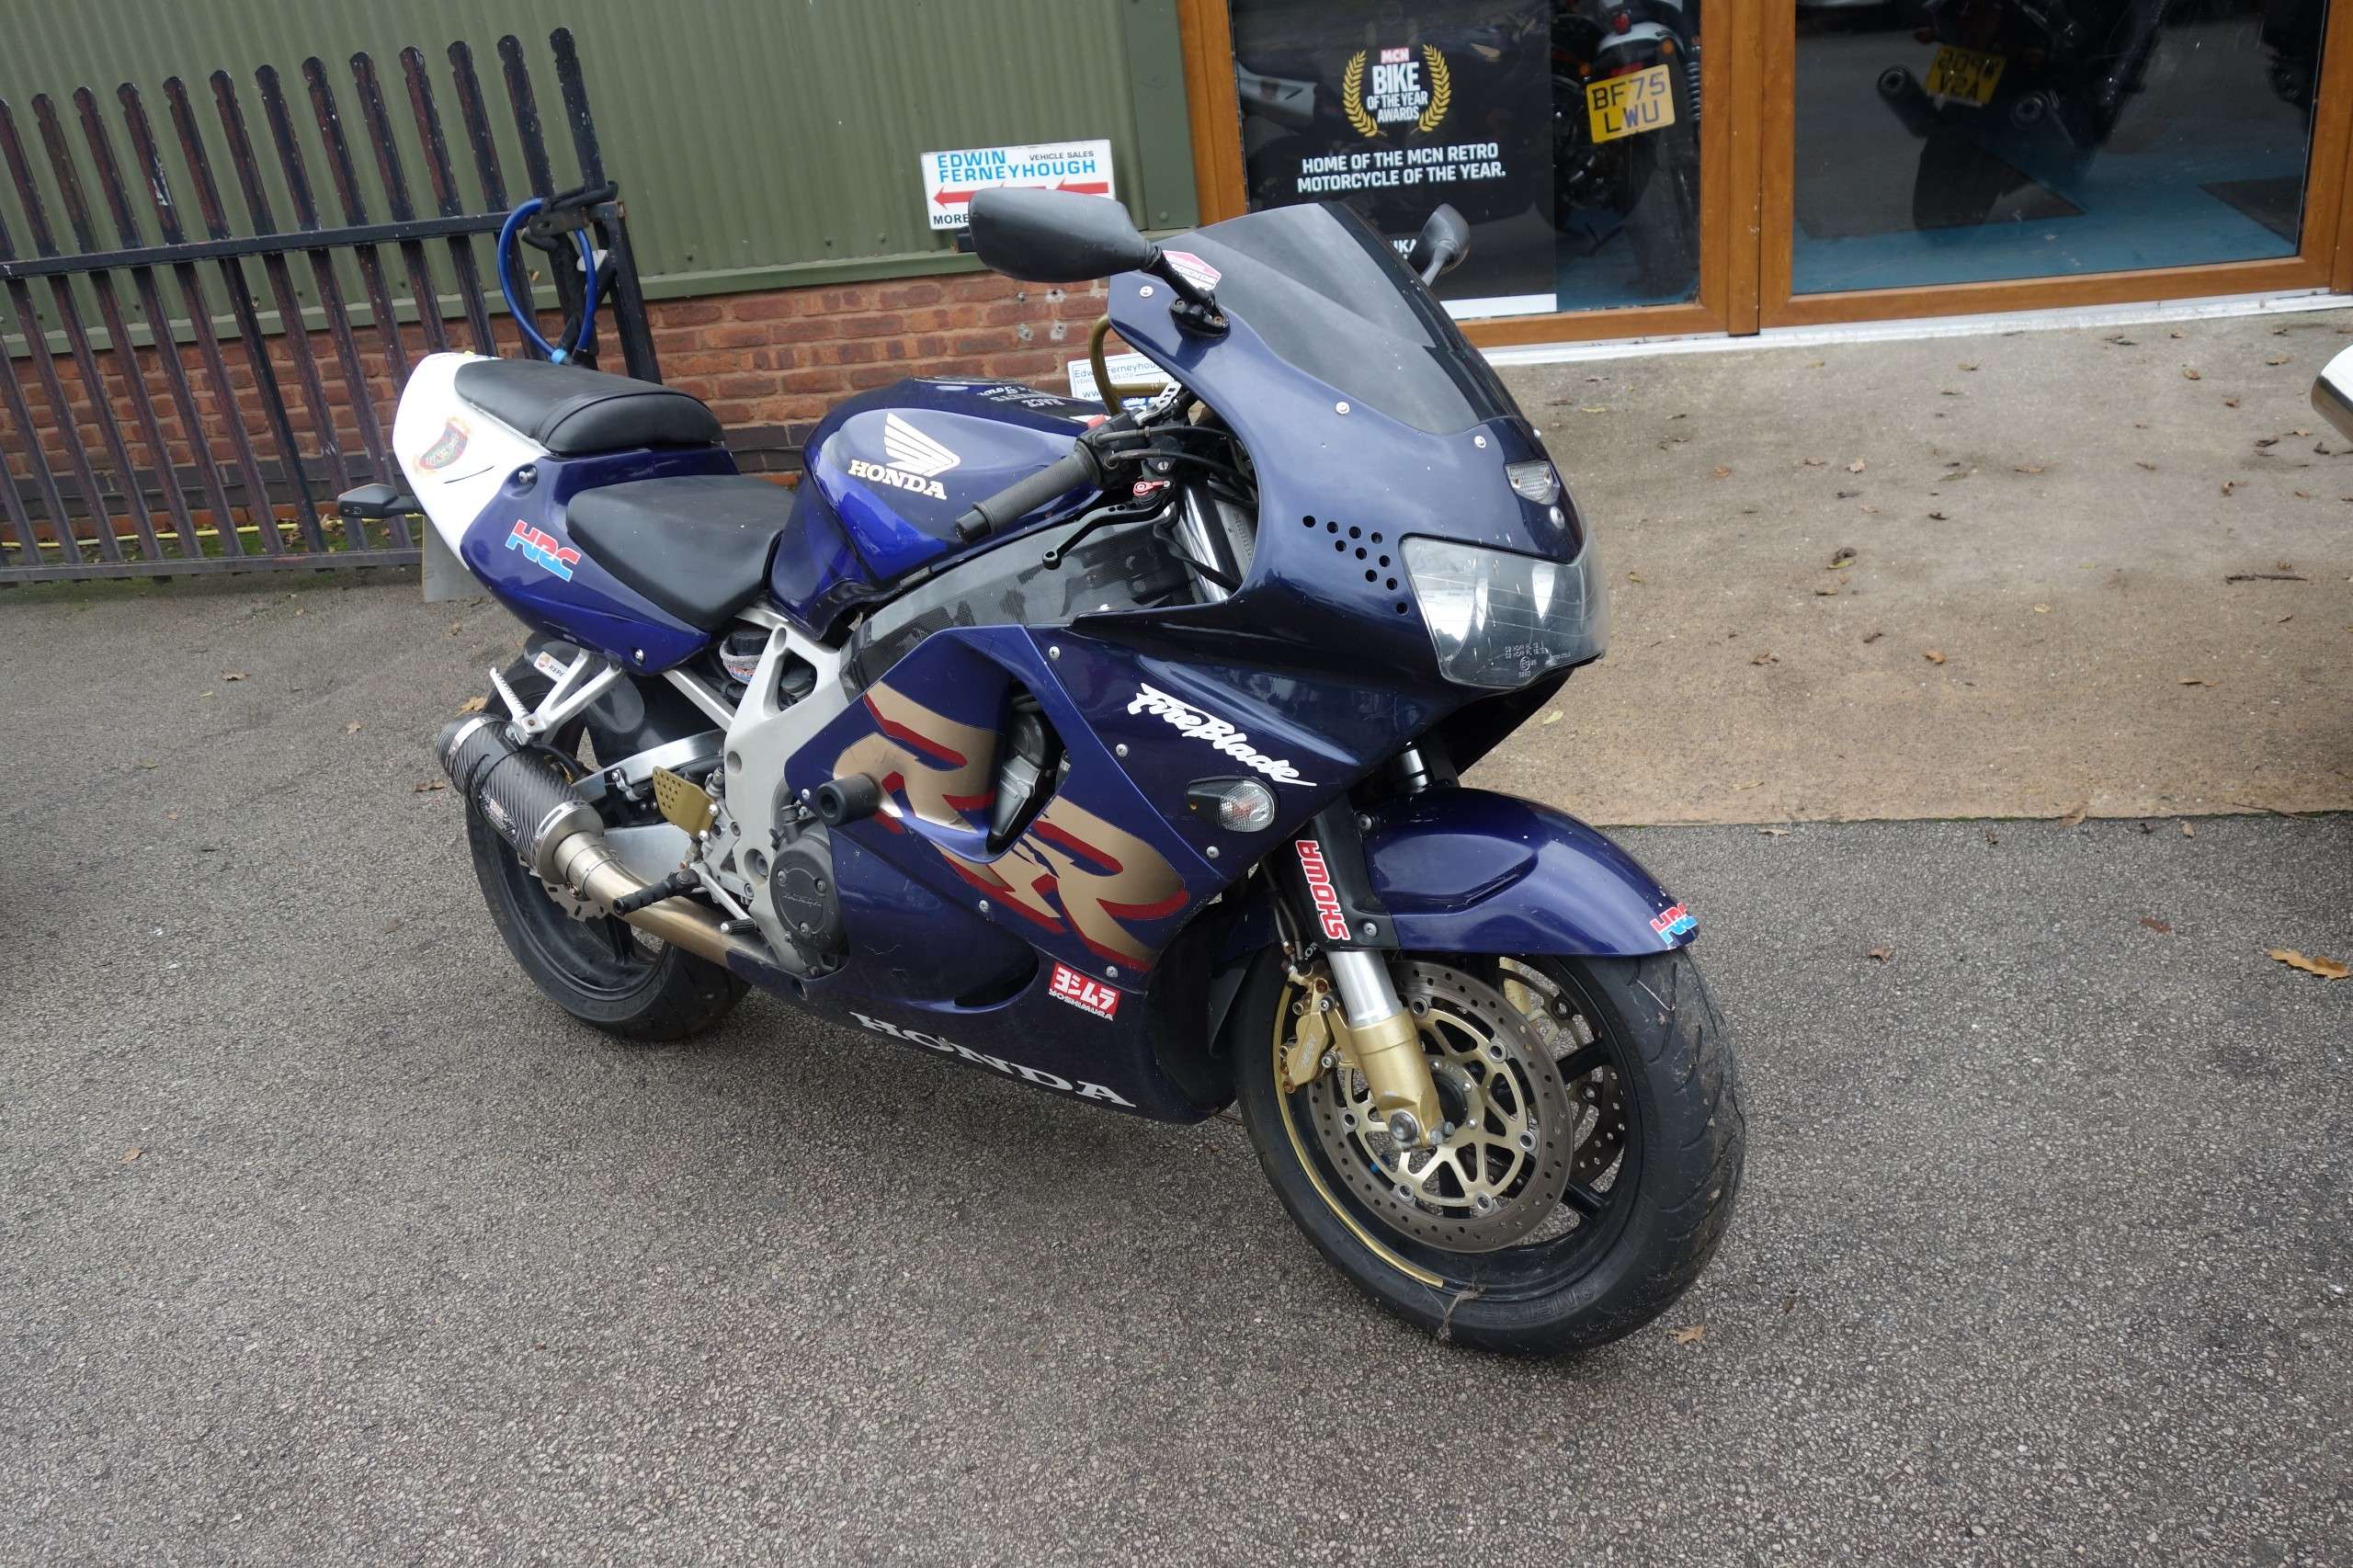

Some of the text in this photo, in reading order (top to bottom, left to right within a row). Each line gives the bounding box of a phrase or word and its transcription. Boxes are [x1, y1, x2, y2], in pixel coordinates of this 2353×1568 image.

[1381, 49, 1409, 63] MCN
[1372, 62, 1420, 95] BIKE
[1592, 72, 1665, 111] BF75
[1367, 91, 1428, 109] OF THE YEAR
[1377, 106, 1420, 123] AWARDS
[1604, 100, 1660, 133] LWU
[938, 150, 1095, 168] EDWIN VEHICLE SALES
[938, 160, 1097, 183] FERNEYHOUGH
[1302, 142, 1499, 174] HOME OF THE MCN RETRO
[1297, 162, 1506, 193] MOTORCYCLE OF THE YEAR.
[933, 213, 970, 225] MORE
[1107, 361, 1157, 373] erneyhou
[847, 460, 948, 501] HONDA
[506, 519, 582, 582] HRC
[1295, 840, 1351, 940] SHOWA
[1053, 966, 1117, 1010] ヨシムラ
[1048, 988, 1114, 1022] YOSHIMURA
[849, 1011, 1137, 1108] HONDA
